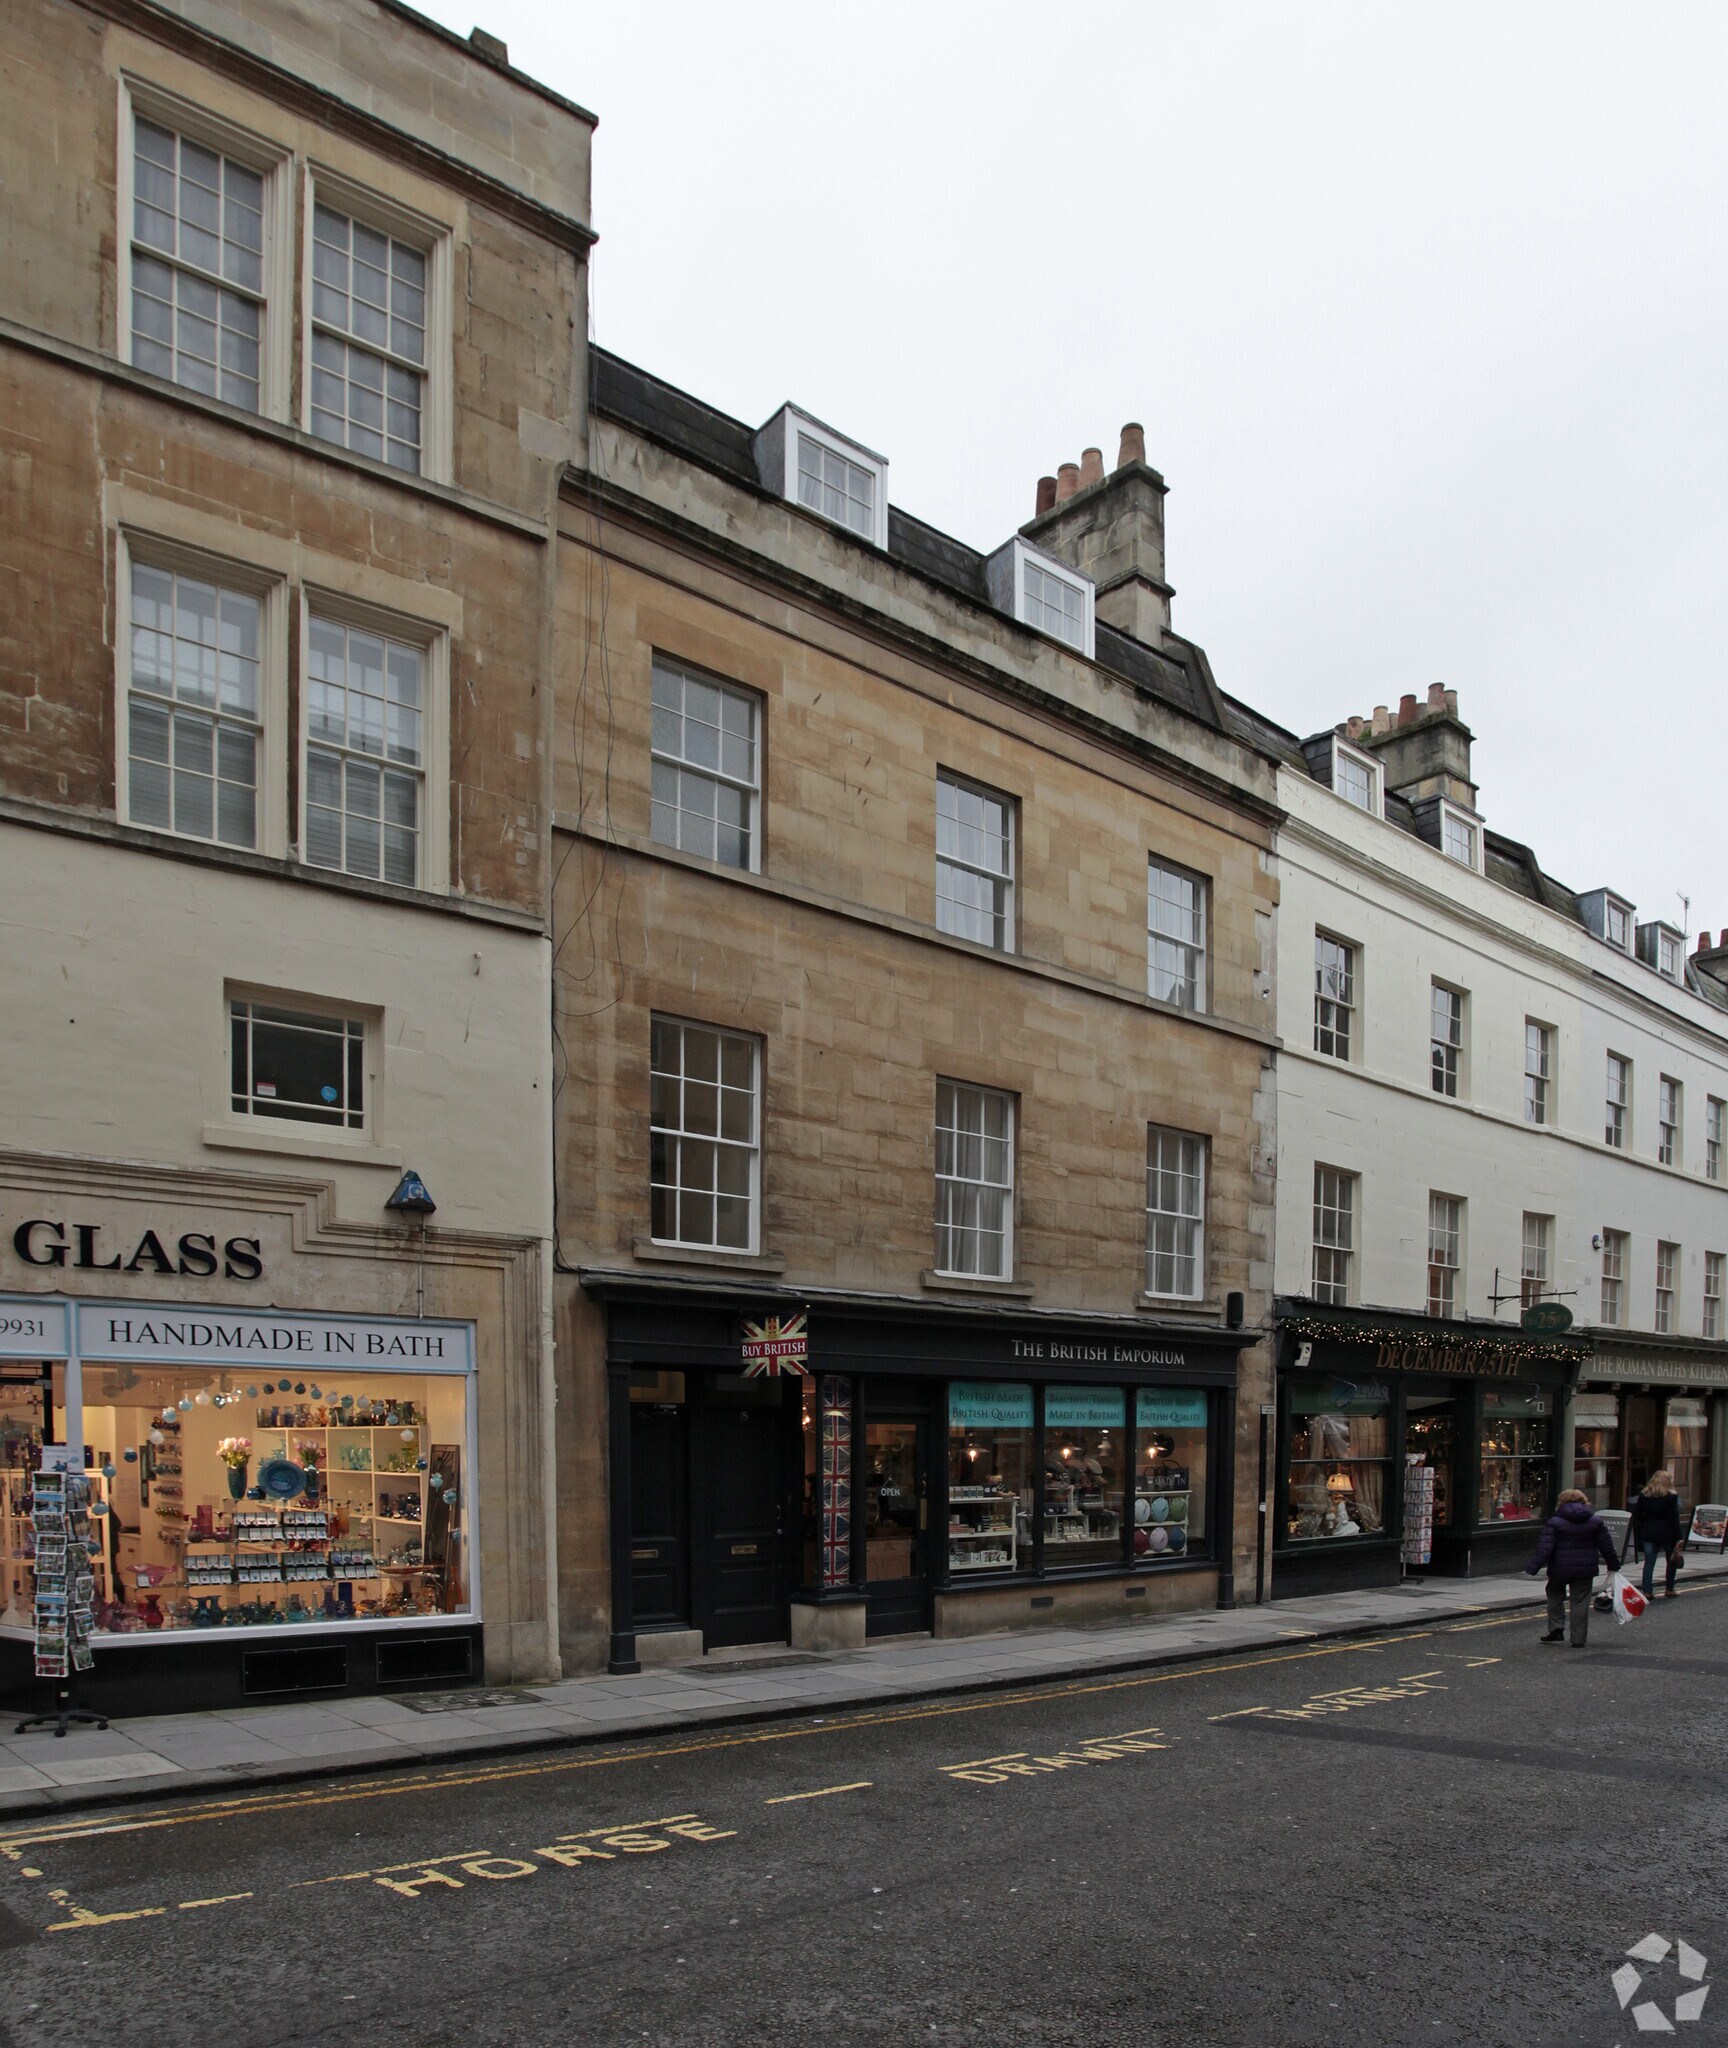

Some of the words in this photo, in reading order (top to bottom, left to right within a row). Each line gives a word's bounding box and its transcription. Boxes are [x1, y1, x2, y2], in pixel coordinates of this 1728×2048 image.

[14, 1220, 262, 1280] GLASS
[0, 1318, 44, 1337] 9931
[109, 1320, 314, 1352] HANDMADE
[325, 1331, 356, 1353] IN
[366, 1334, 445, 1358] BATH
[742, 1345, 761, 1357] BUY
[764, 1342, 806, 1355] BRITISH
[1011, 1339, 1044, 1358] THE
[1050, 1342, 1107, 1361] BRITISH
[1113, 1346, 1185, 1365] EMPORIUM
[1376, 1344, 1476, 1374] DECEMBER
[1478, 1352, 1521, 1376] 25TH
[1591, 1355, 1614, 1373] THE
[1616, 1356, 1654, 1376] ROMAN
[958, 1390, 994, 1402] BRITISH
[997, 1392, 1025, 1403] MADE
[1090, 1394, 1120, 1405] THINGS
[952, 1407, 988, 1418] BRITISH
[991, 1408, 1030, 1422] QUALITY
[1049, 1410, 1074, 1420] MADE
[1076, 1411, 1086, 1420] IN
[1088, 1410, 1120, 1420] BRITAIN
[1140, 1411, 1168, 1422] BRITISH
[1170, 1411, 1201, 1423] QUALITY
[880, 1487, 901, 1497] OPEN
[374, 1821, 738, 1898] HORSE
[948, 1740, 1173, 1784] DRAWN
